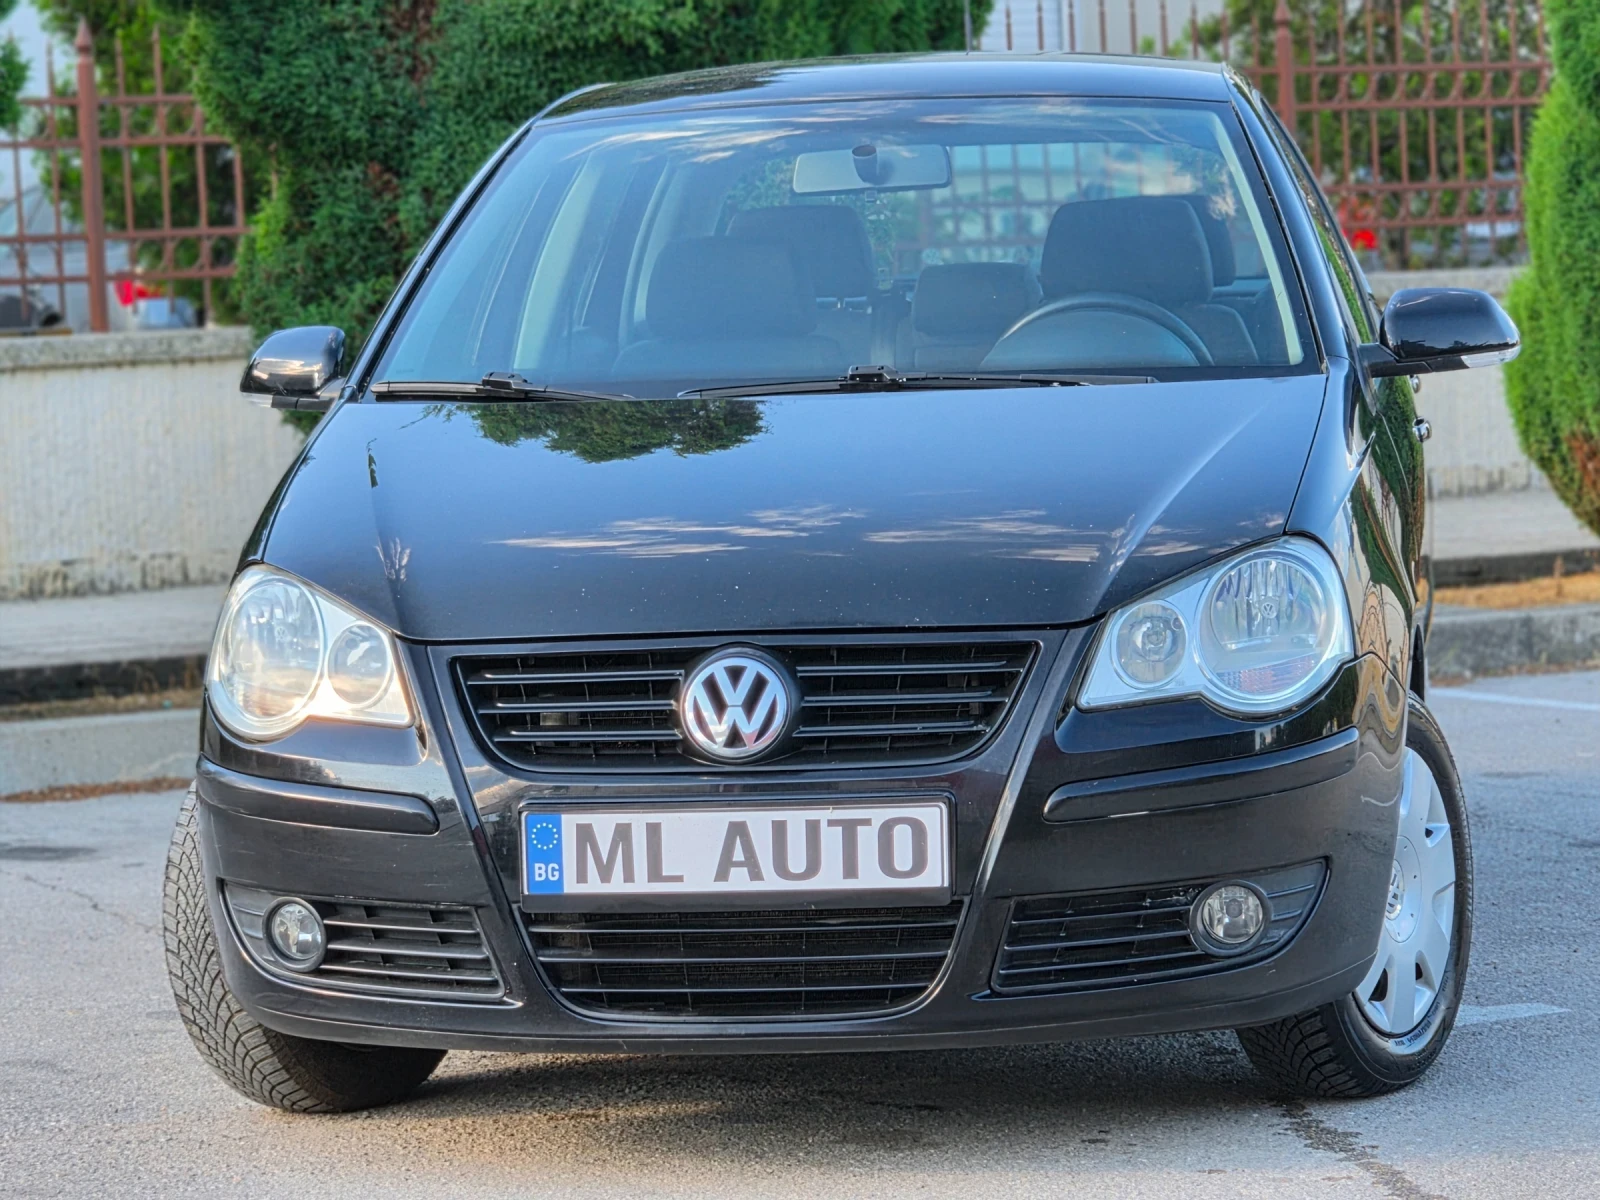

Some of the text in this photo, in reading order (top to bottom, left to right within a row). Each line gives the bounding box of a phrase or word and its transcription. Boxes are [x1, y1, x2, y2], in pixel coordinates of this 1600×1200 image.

[684, 656, 788, 758] VW
[534, 863, 560, 881] BG
[574, 815, 929, 884] ML AUTO
